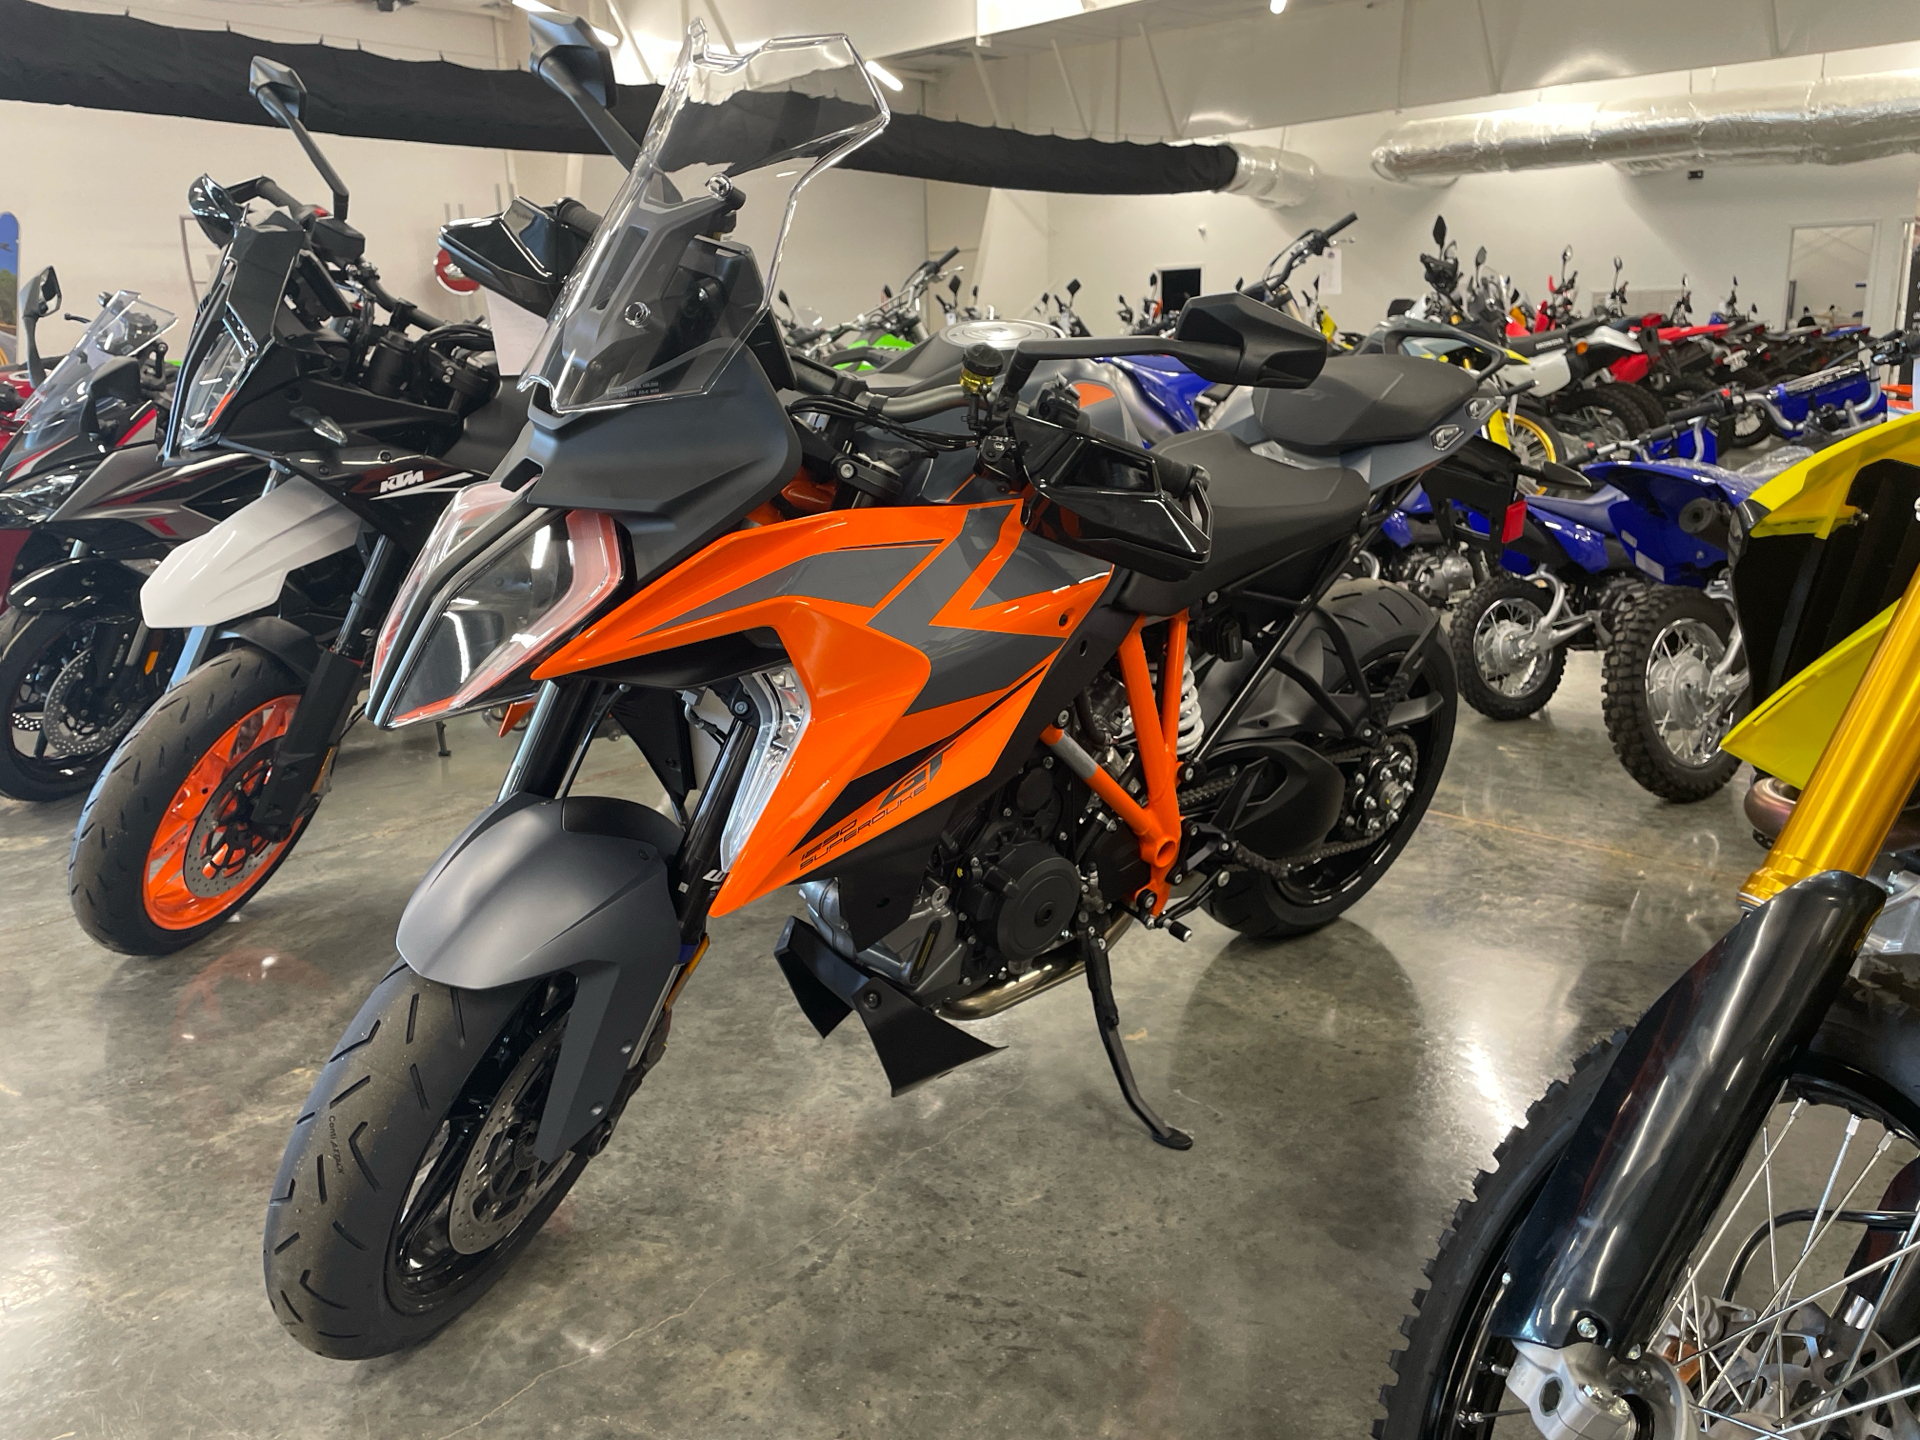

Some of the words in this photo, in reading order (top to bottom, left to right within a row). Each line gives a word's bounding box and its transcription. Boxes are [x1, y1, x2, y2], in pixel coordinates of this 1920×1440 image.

[380, 470, 424, 493] KTM
[876, 740, 957, 812] GT
[800, 782, 927, 871] SUPERDUKE
[801, 819, 857, 861] 1290
